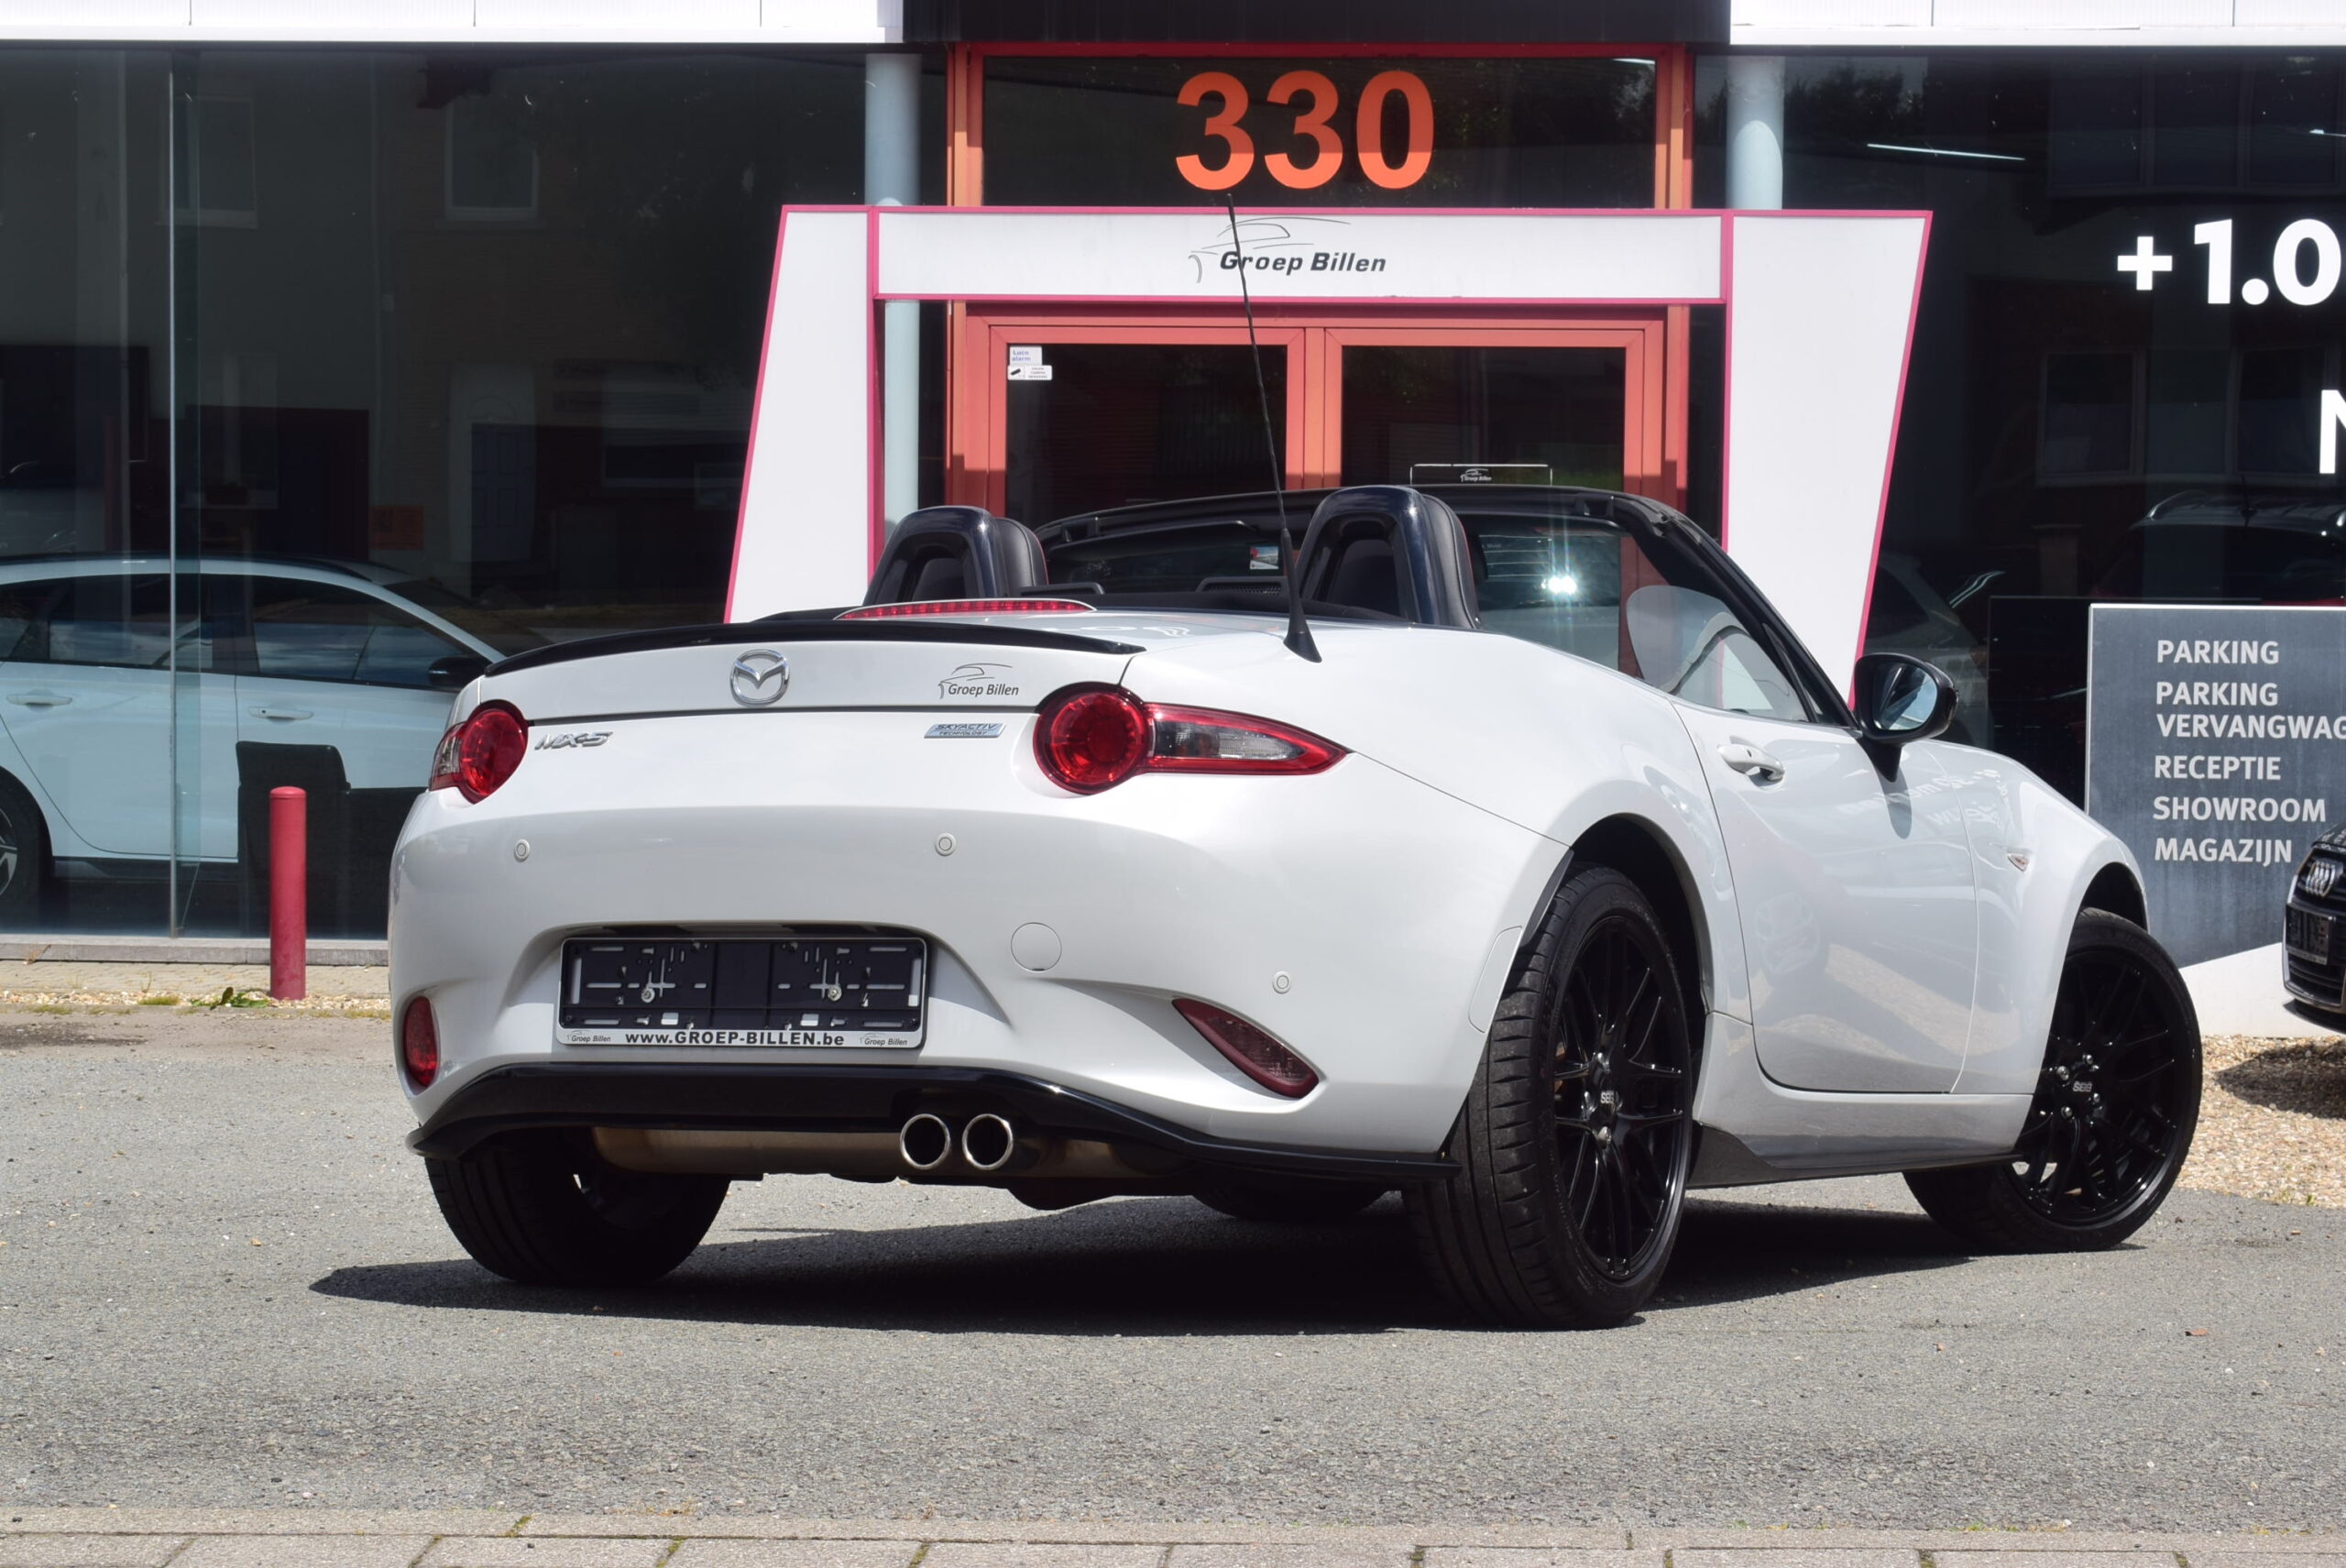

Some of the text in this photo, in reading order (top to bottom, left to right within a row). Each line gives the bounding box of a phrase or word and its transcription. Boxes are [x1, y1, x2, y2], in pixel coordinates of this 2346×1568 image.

[1176, 70, 1434, 191] 330
[1220, 250, 1387, 276] Groep Billen
[2157, 640, 2280, 664] PARKING
[948, 683, 1020, 697] Groep Billen
[2156, 682, 2279, 706] PARKING
[534, 732, 613, 751] MX-5
[2154, 755, 2281, 780] RECEPTIE
[2154, 795, 2326, 822] SHOWROOM
[2154, 838, 2292, 867] MAGAZIJN
[571, 1035, 591, 1043] Groep
[625, 1031, 845, 1046] www.GROEP-BILLEN.be
[864, 1037, 908, 1047] Groep Billen
